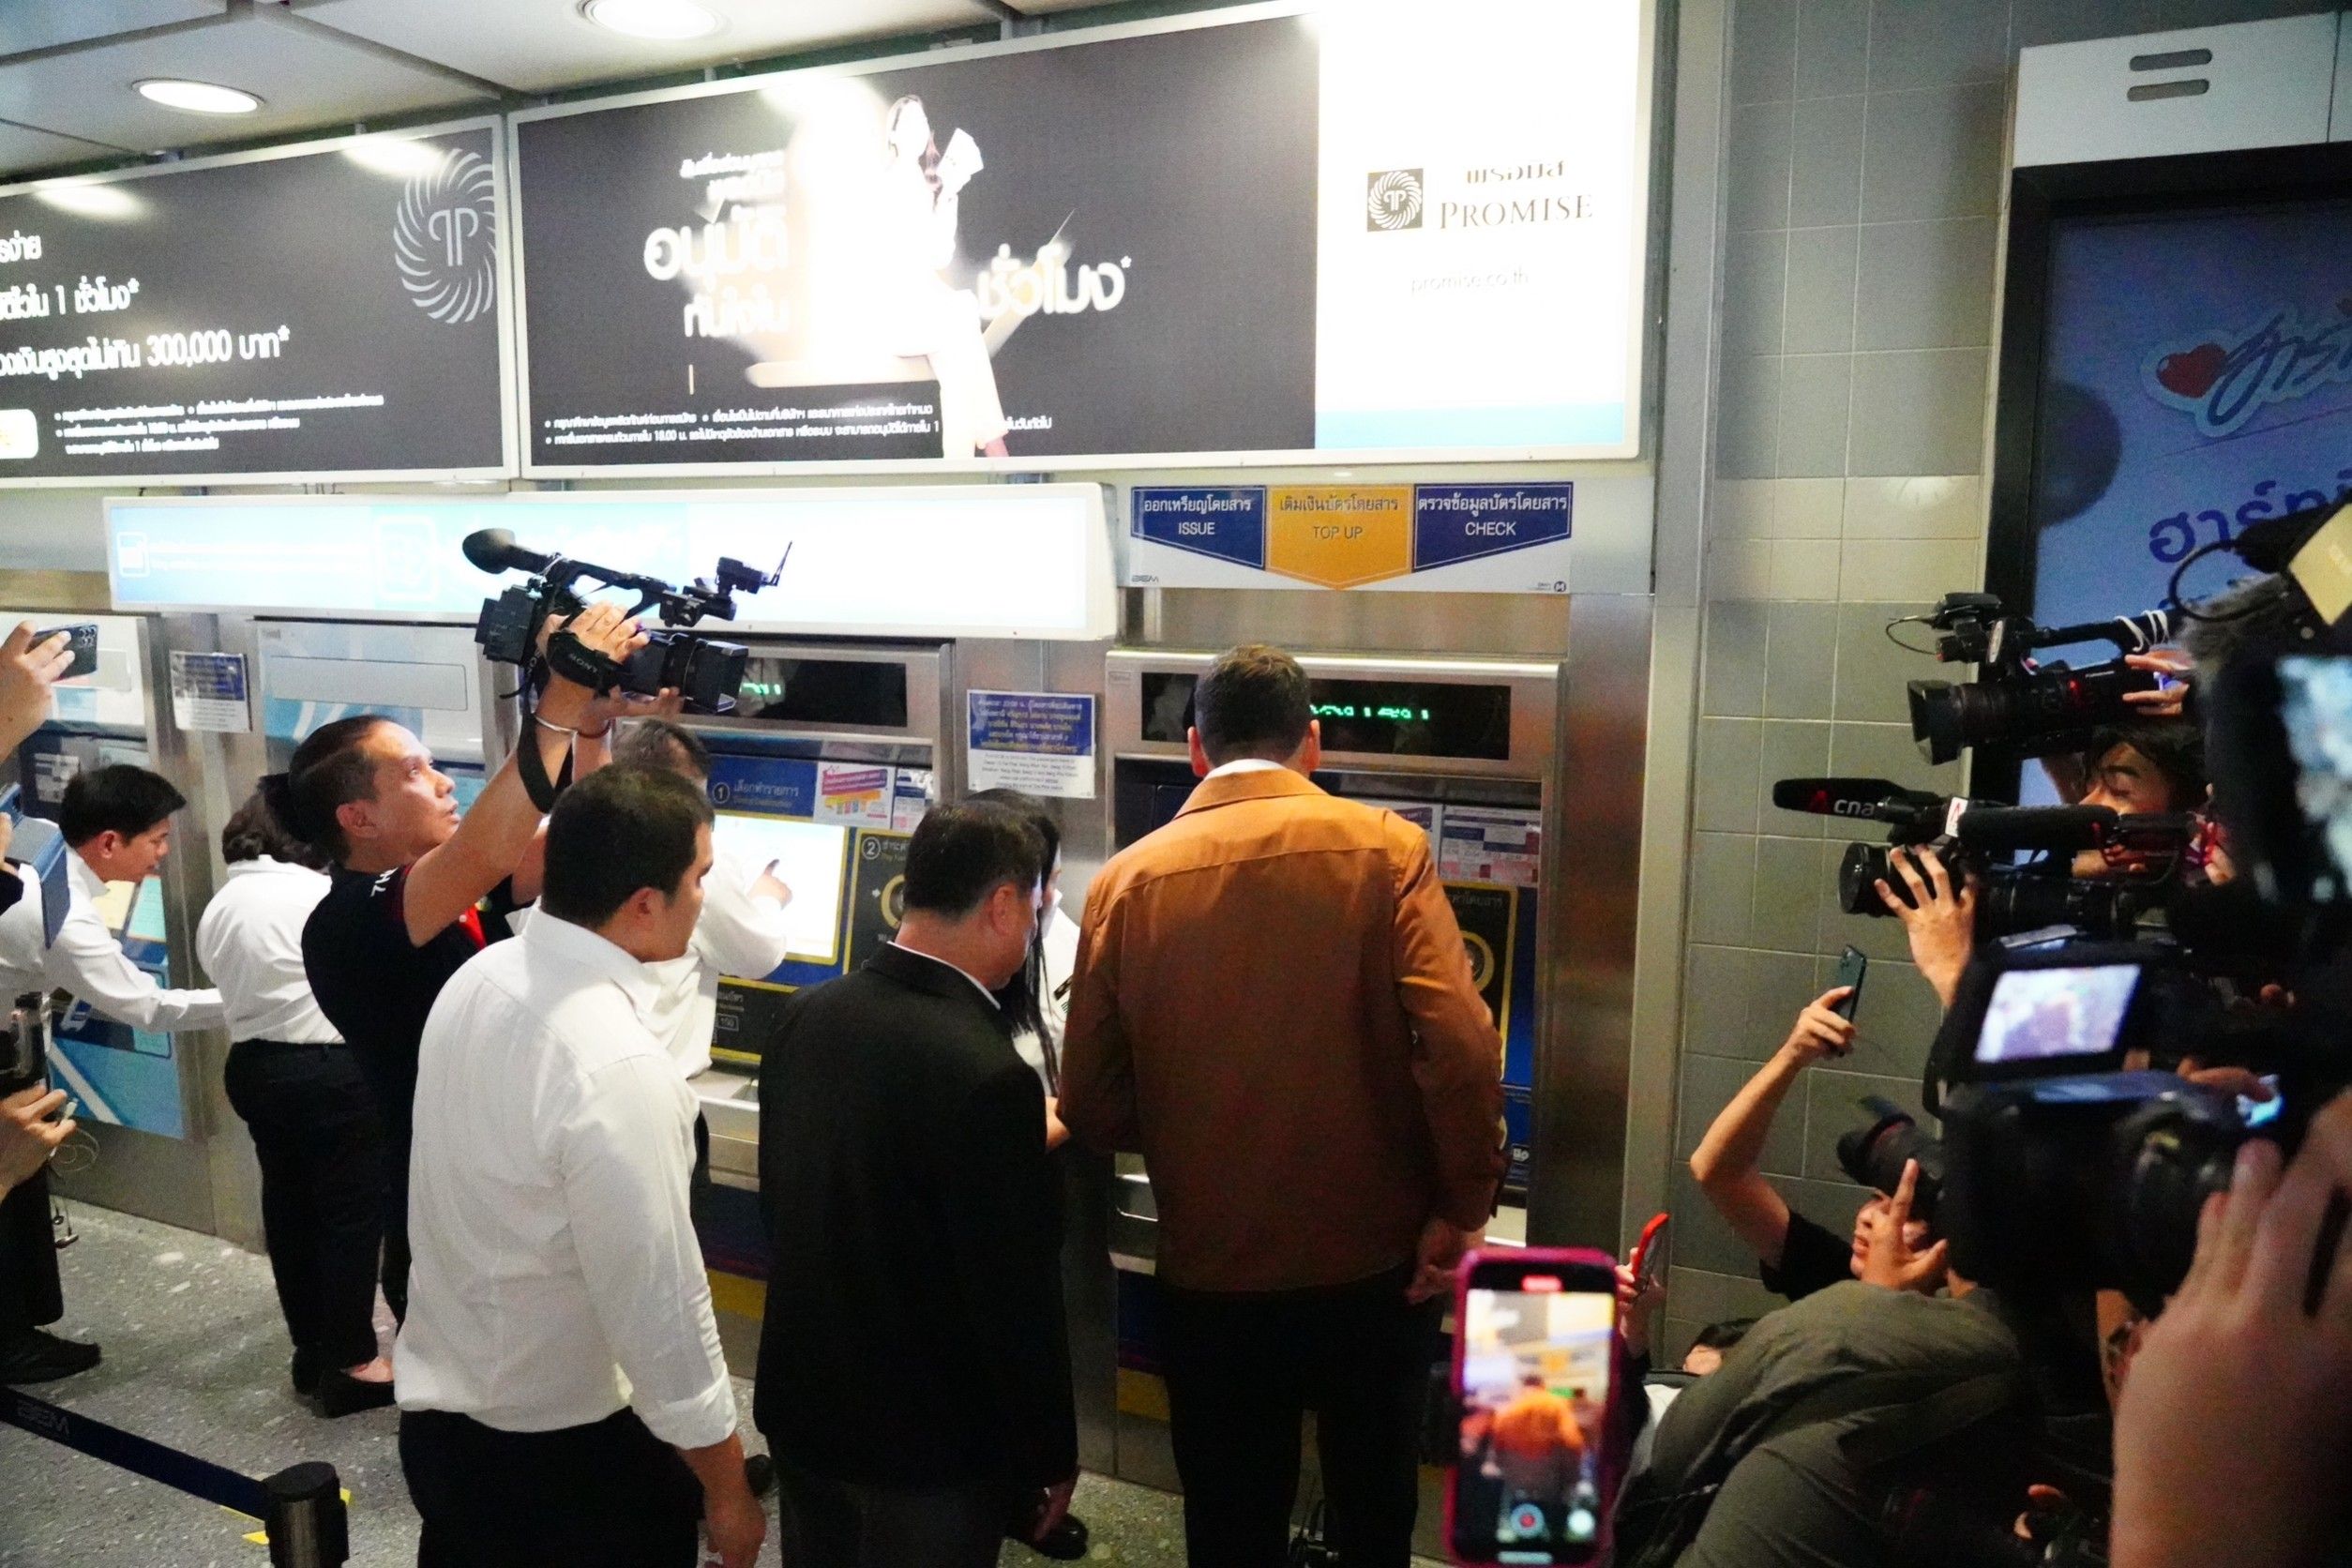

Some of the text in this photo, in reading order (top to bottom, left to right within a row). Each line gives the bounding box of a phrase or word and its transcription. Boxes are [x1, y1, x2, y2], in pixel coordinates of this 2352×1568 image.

[1440, 194, 1593, 229] PROMISE
[55, 285, 66, 315] 1
[146, 329, 233, 367] 300,000
[1144, 494, 1252, 515] ออกเหรียญโดยสาร
[1279, 493, 1399, 513] เติมเงินบัตรโดยสาร
[1417, 491, 1568, 517] ตรวจข้อมูลบัตรโดยสาร
[1177, 521, 1216, 535] ISSUE
[1313, 526, 1364, 539] TOP UP
[1464, 521, 1517, 536] CHECK
[1832, 798, 1876, 818] cna
